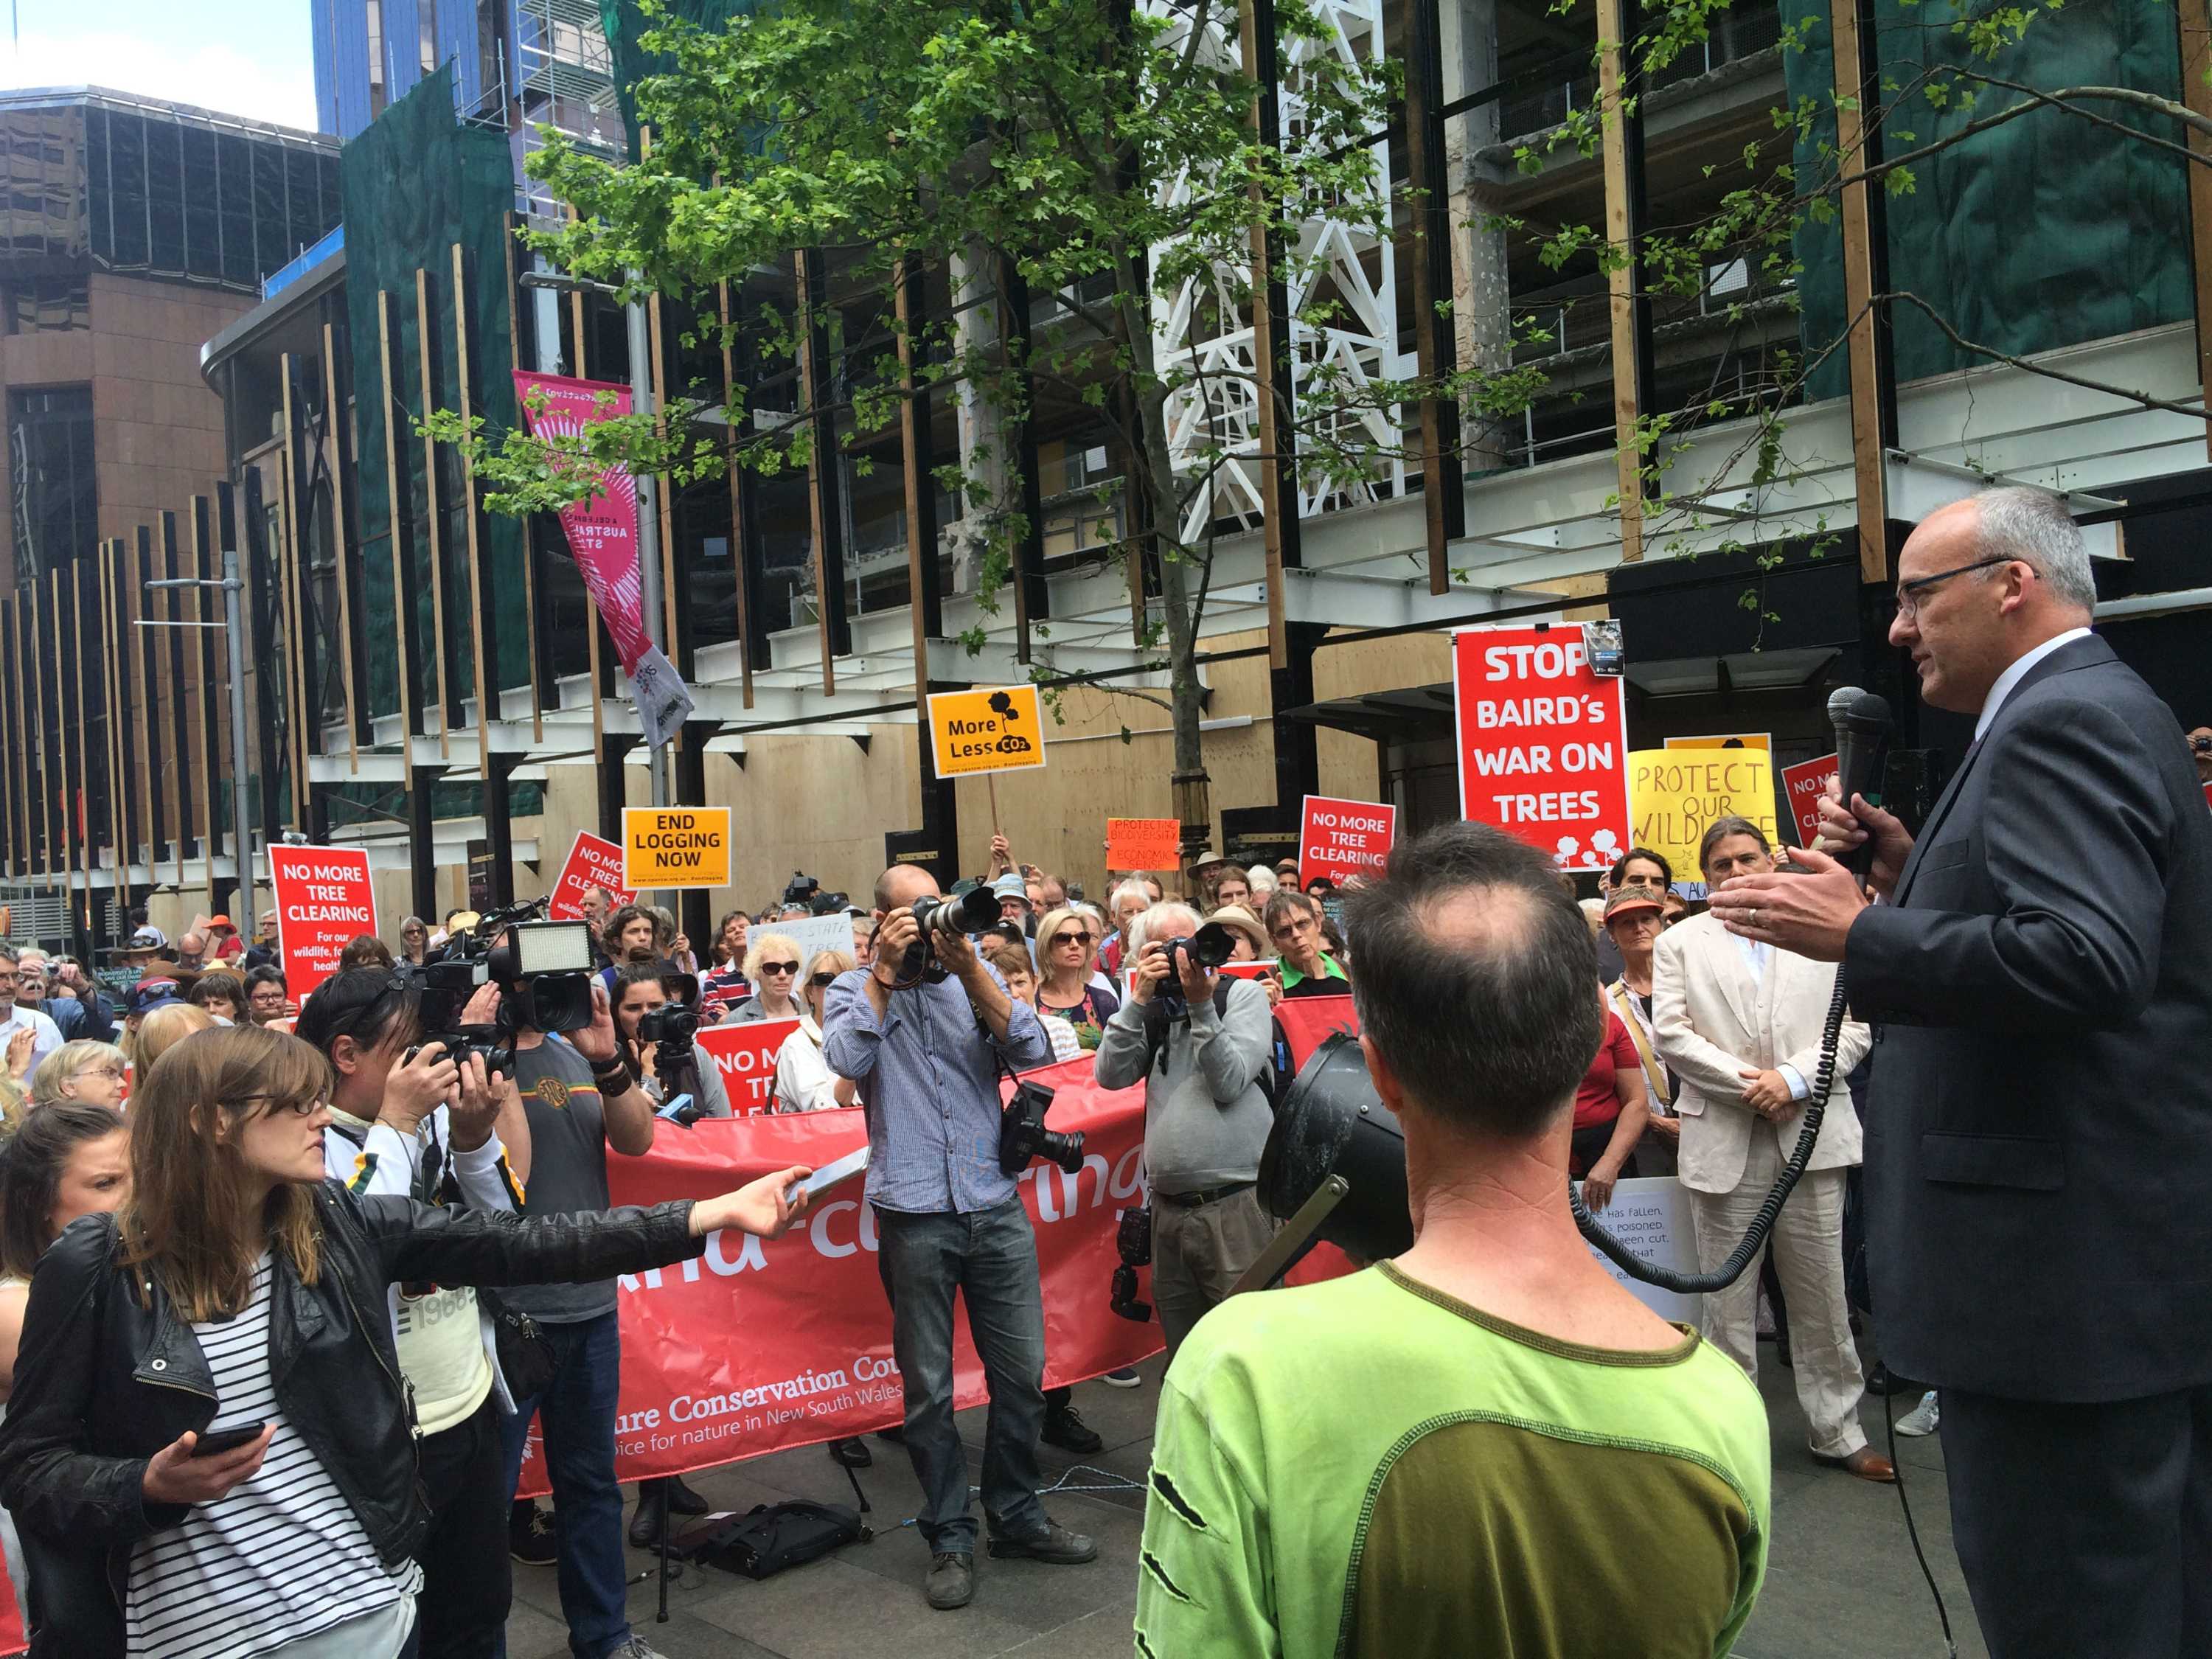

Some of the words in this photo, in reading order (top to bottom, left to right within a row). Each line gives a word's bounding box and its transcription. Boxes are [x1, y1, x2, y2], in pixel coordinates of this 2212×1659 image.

[1484, 642, 1588, 681] STOP
[948, 719, 996, 736] More
[950, 742, 992, 758] Less
[1473, 745, 1554, 776] WAR
[1560, 742, 1613, 773] ON
[1637, 762, 1764, 793] PROTECT
[1794, 778, 1815, 795] NO
[1492, 790, 1600, 824] TREES
[1683, 795, 1736, 818] OUR
[657, 815, 695, 830] END
[1312, 813, 1337, 827] NO
[1340, 815, 1386, 833] MORE
[636, 832, 720, 849] LOGGING
[1329, 831, 1367, 848] TREE
[579, 846, 601, 863] NO
[602, 855, 623, 873] MO
[655, 852, 701, 867] NOW
[1309, 846, 1384, 866] CLEARING
[283, 864, 310, 880] NO
[313, 865, 364, 882] MORE
[590, 866, 620, 888] TREE
[1329, 869, 1344, 880] For
[306, 885, 348, 902] TREE
[288, 905, 369, 922] CLEARING
[317, 931, 333, 942] For
[334, 933, 349, 942] our
[293, 946, 332, 958] wildlife,
[714, 1050, 755, 1074] NO
[614, 1408, 661, 1436] ure
[669, 1368, 849, 1424] Conservation
[650, 1433, 676, 1451] for
[682, 1420, 740, 1446] nature
[745, 1414, 761, 1431] in
[767, 1406, 804, 1426] New
[807, 1393, 854, 1417] South
[855, 1382, 903, 1405] Wales
